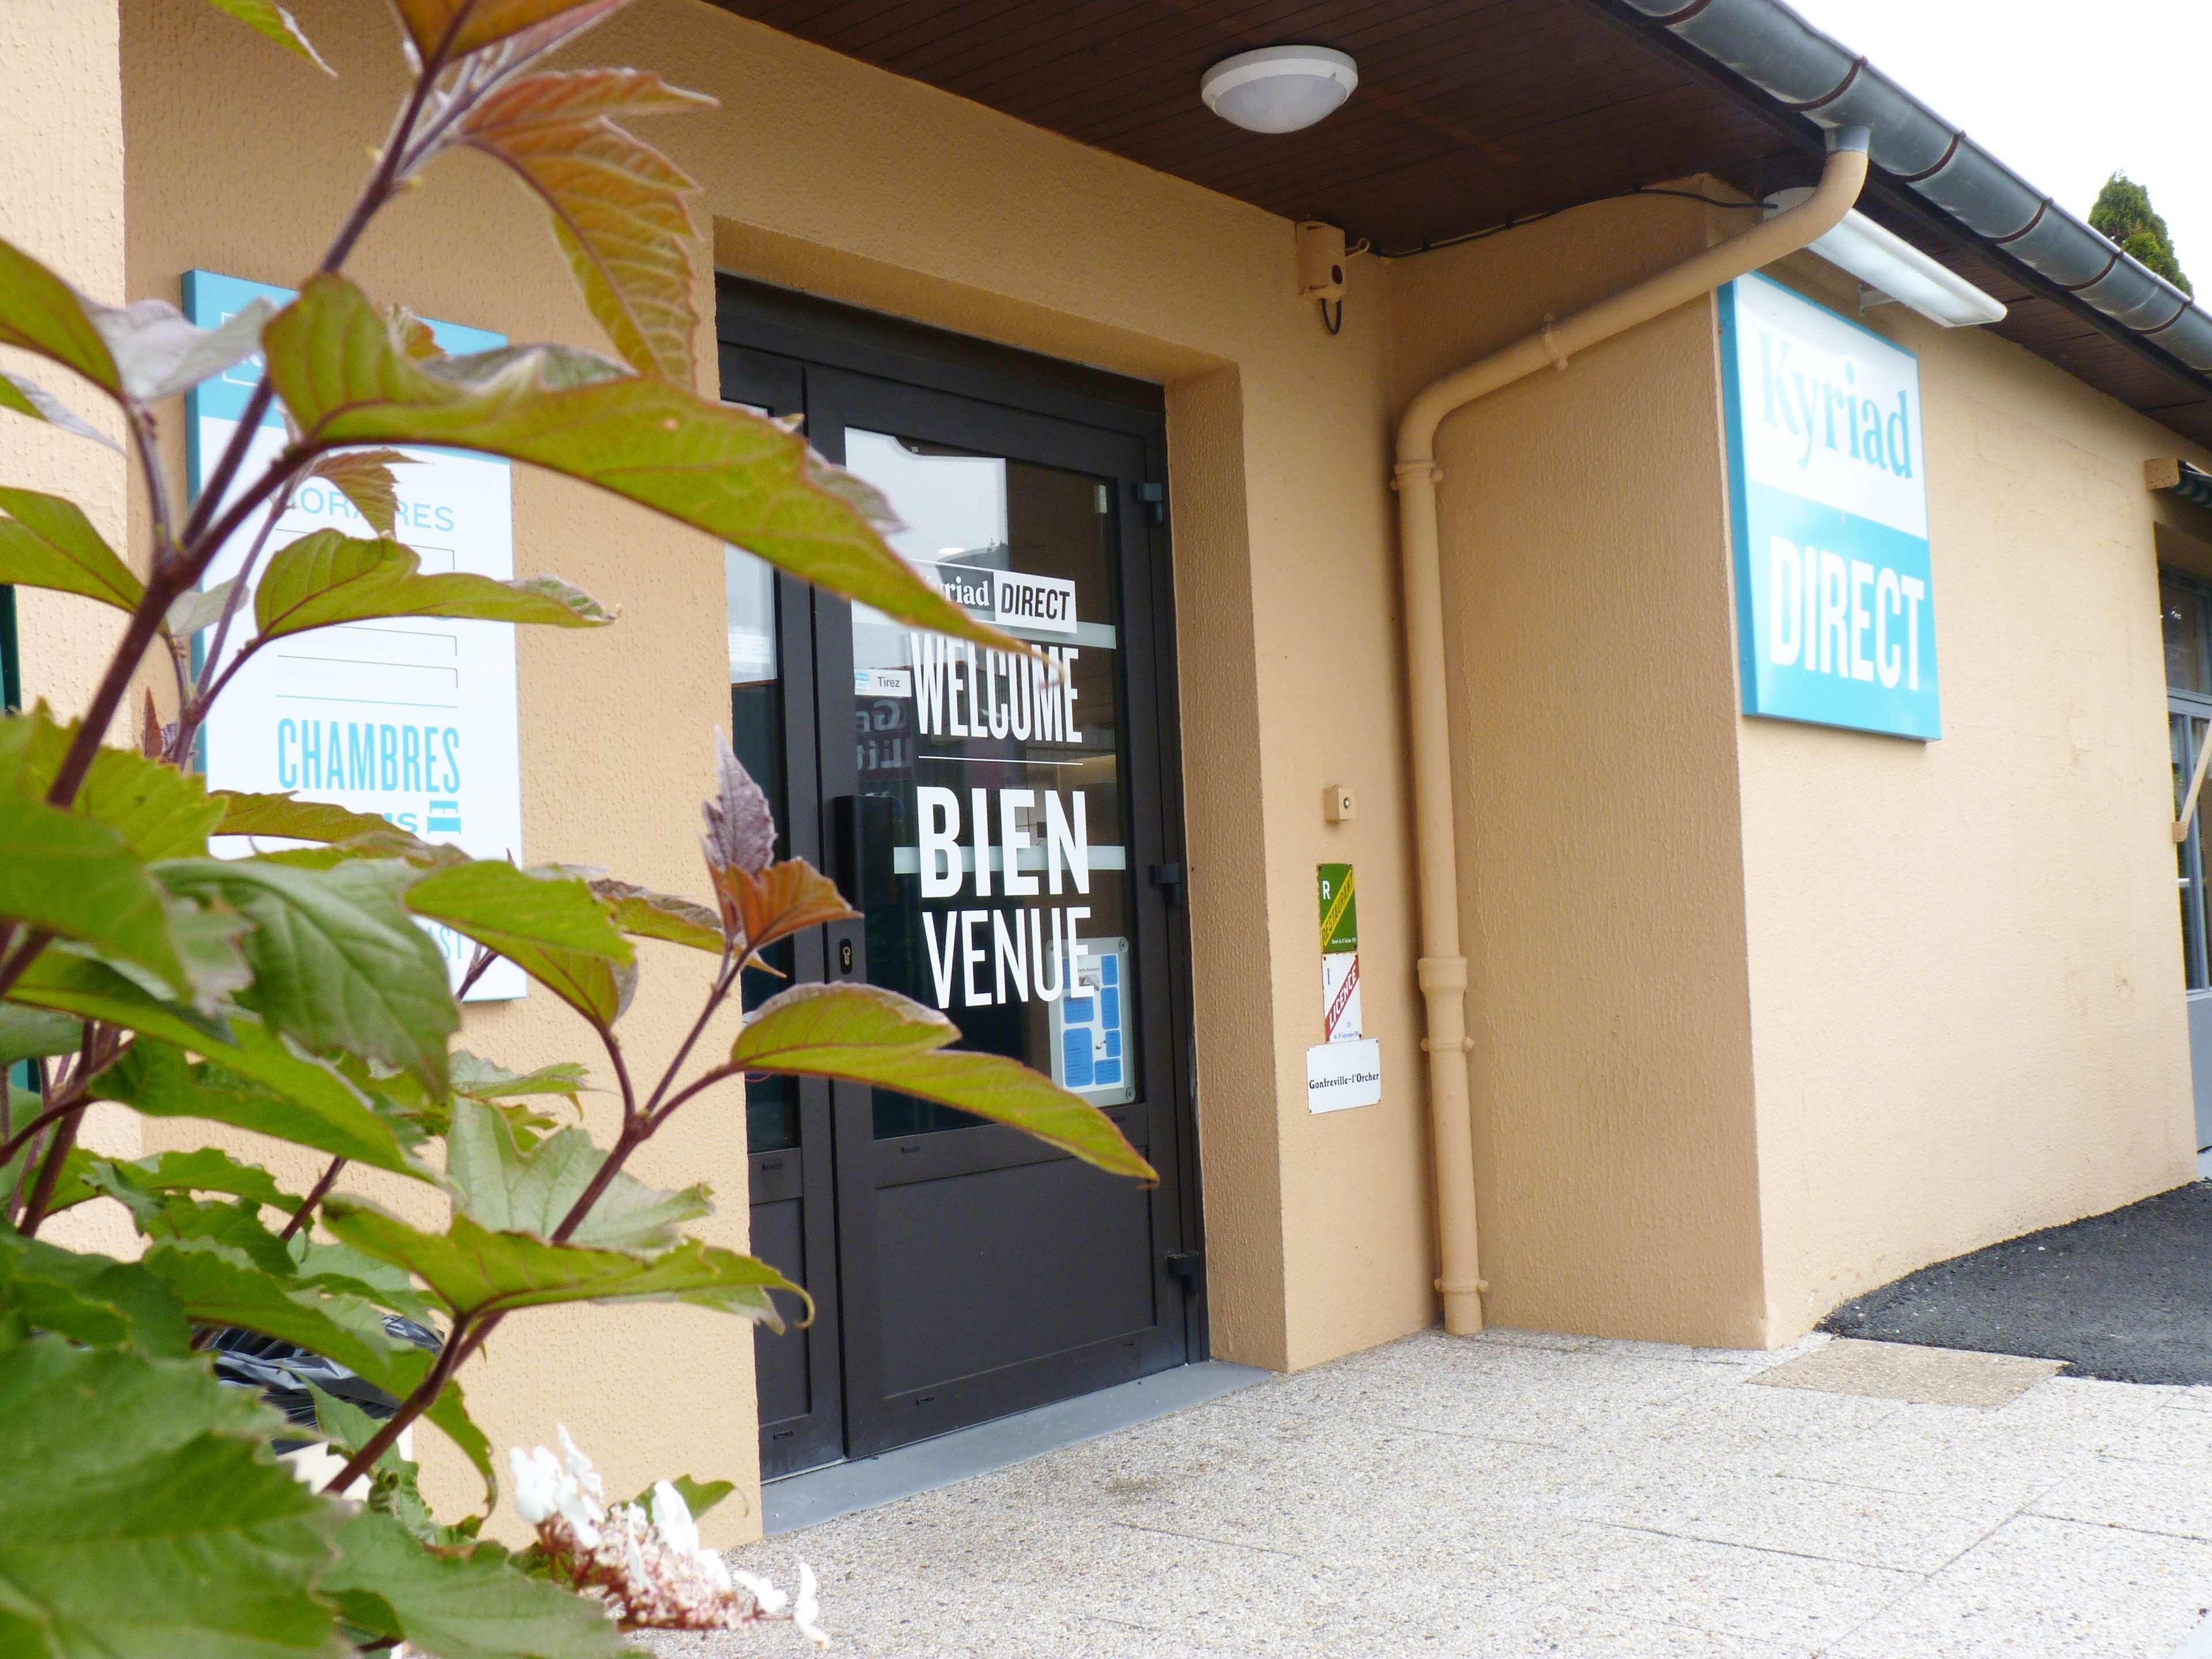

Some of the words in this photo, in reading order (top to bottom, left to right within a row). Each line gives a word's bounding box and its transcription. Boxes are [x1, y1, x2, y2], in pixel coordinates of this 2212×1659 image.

[1757, 328, 1912, 479] Kyriad
[1001, 582, 1070, 620] DIRECT
[1770, 534, 1925, 691] DIRECT
[877, 676, 900, 688] Tirez
[911, 632, 1082, 743] WELCOME
[277, 718, 460, 794] CHAMBRES
[917, 786, 1090, 898] BIEN
[1323, 880, 1331, 900] R
[922, 906, 1094, 1009] VENUE
[1329, 965, 1357, 1030] LICENCE
[1309, 1072, 1379, 1089] Gonfreville-l'Orcher
